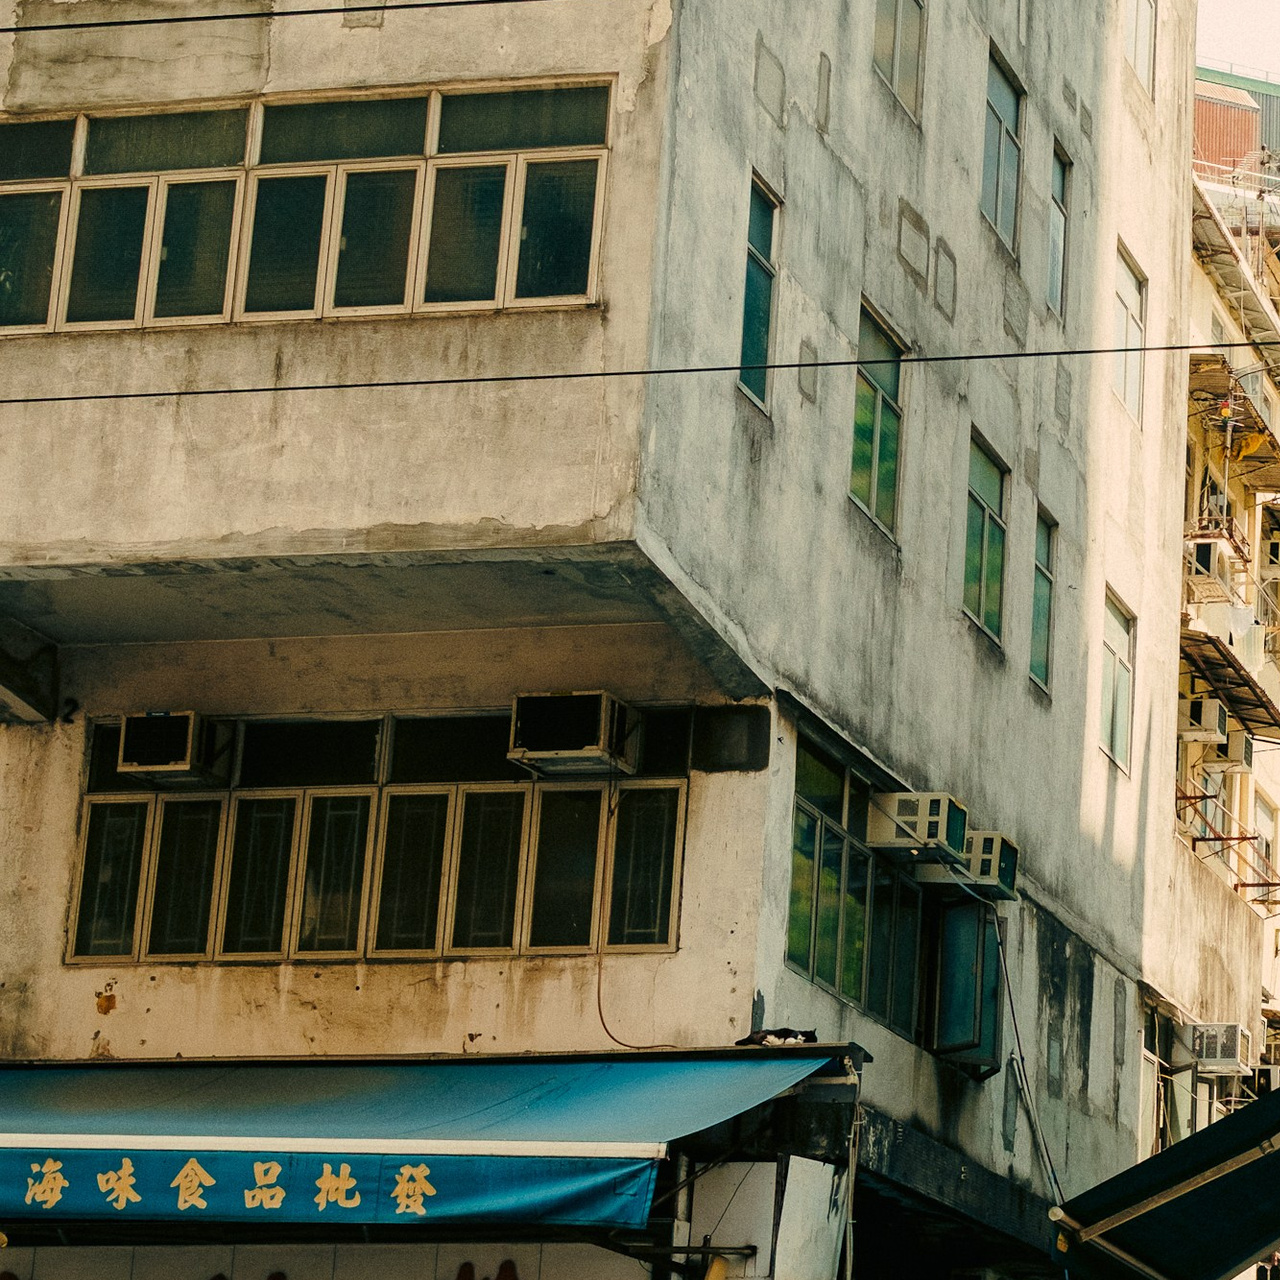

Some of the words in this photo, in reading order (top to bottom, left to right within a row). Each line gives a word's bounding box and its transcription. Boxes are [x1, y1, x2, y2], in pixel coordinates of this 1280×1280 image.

[25, 1157, 438, 1216] 海味食品批發
